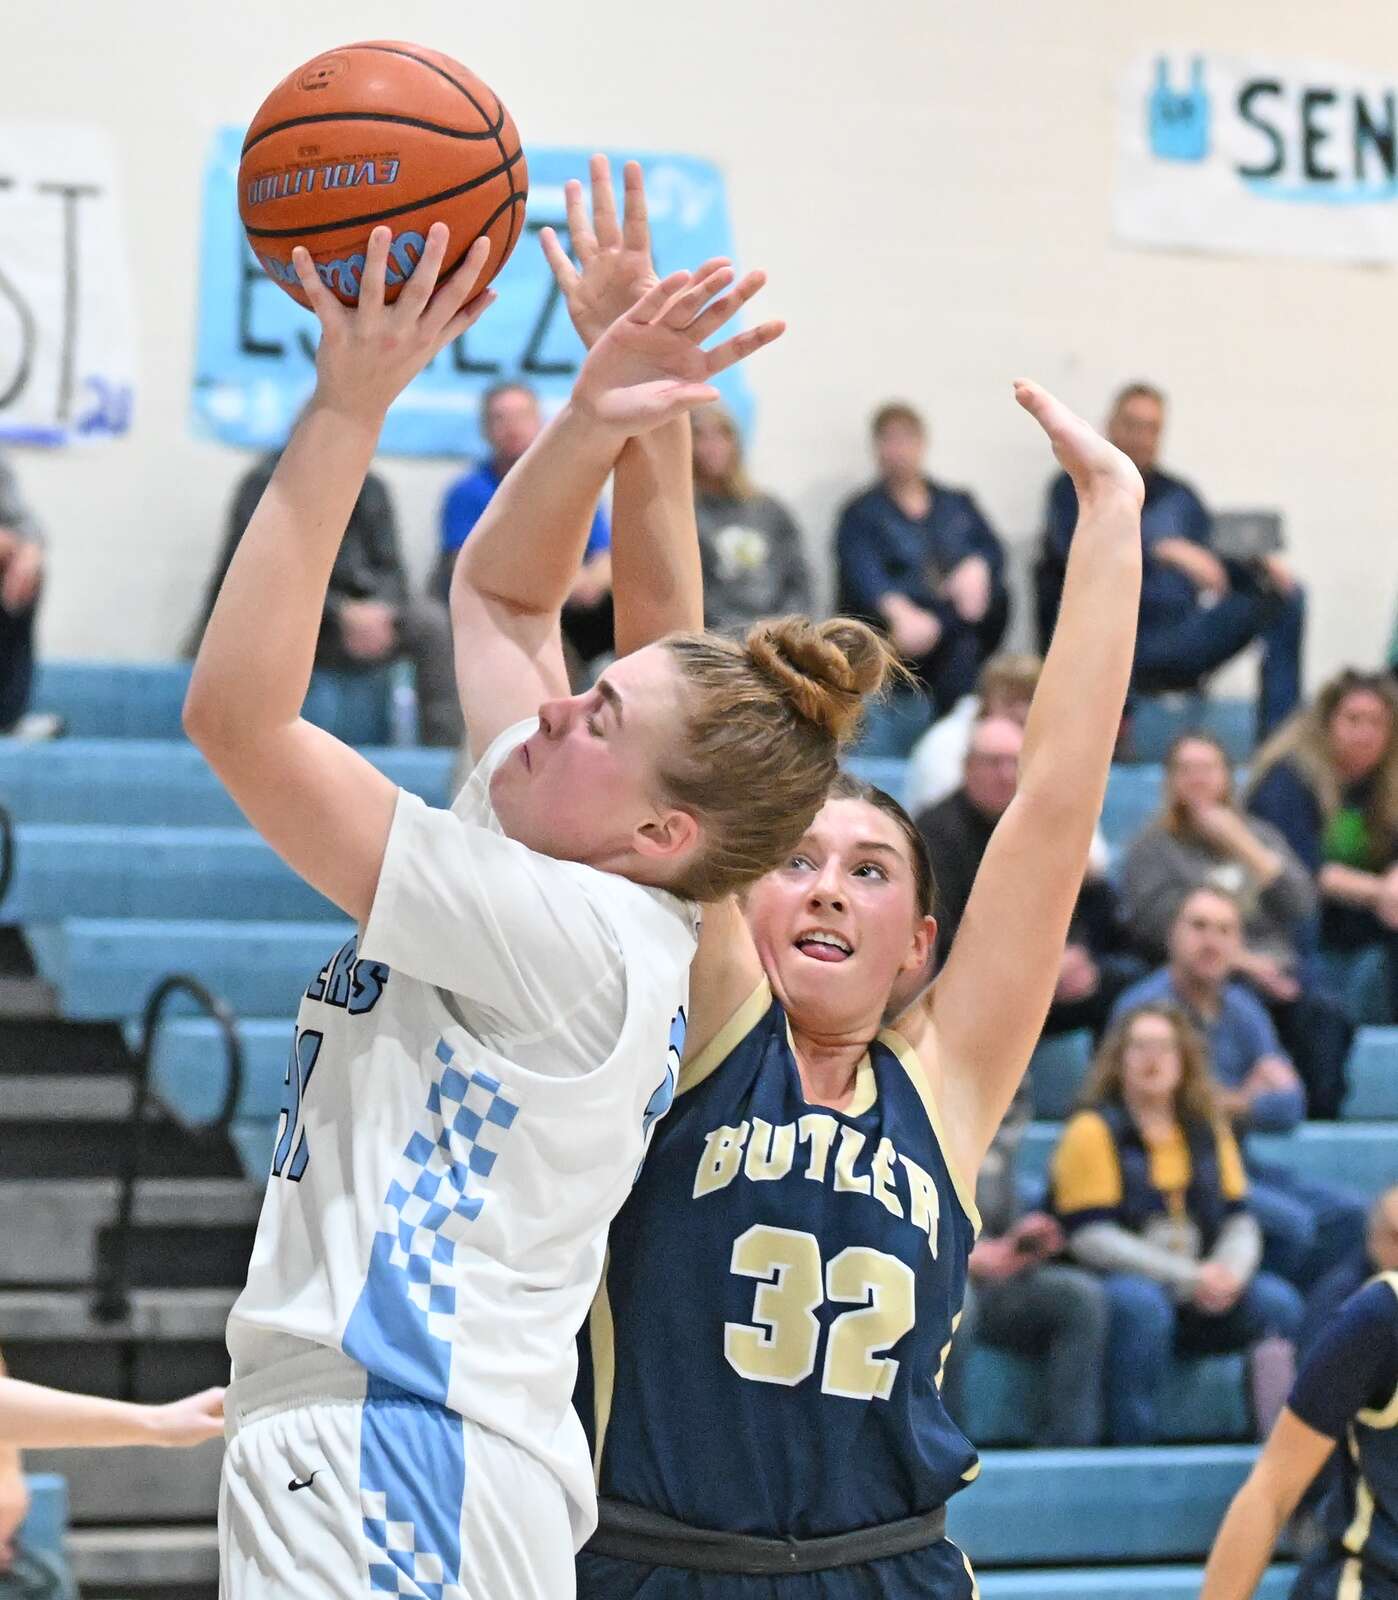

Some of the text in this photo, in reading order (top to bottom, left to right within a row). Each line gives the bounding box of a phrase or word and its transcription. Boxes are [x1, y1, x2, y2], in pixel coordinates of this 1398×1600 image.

[1234, 78, 1398, 182] SEN
[692, 1113, 940, 1261] BUTLER
[724, 1223, 916, 1401] 32
